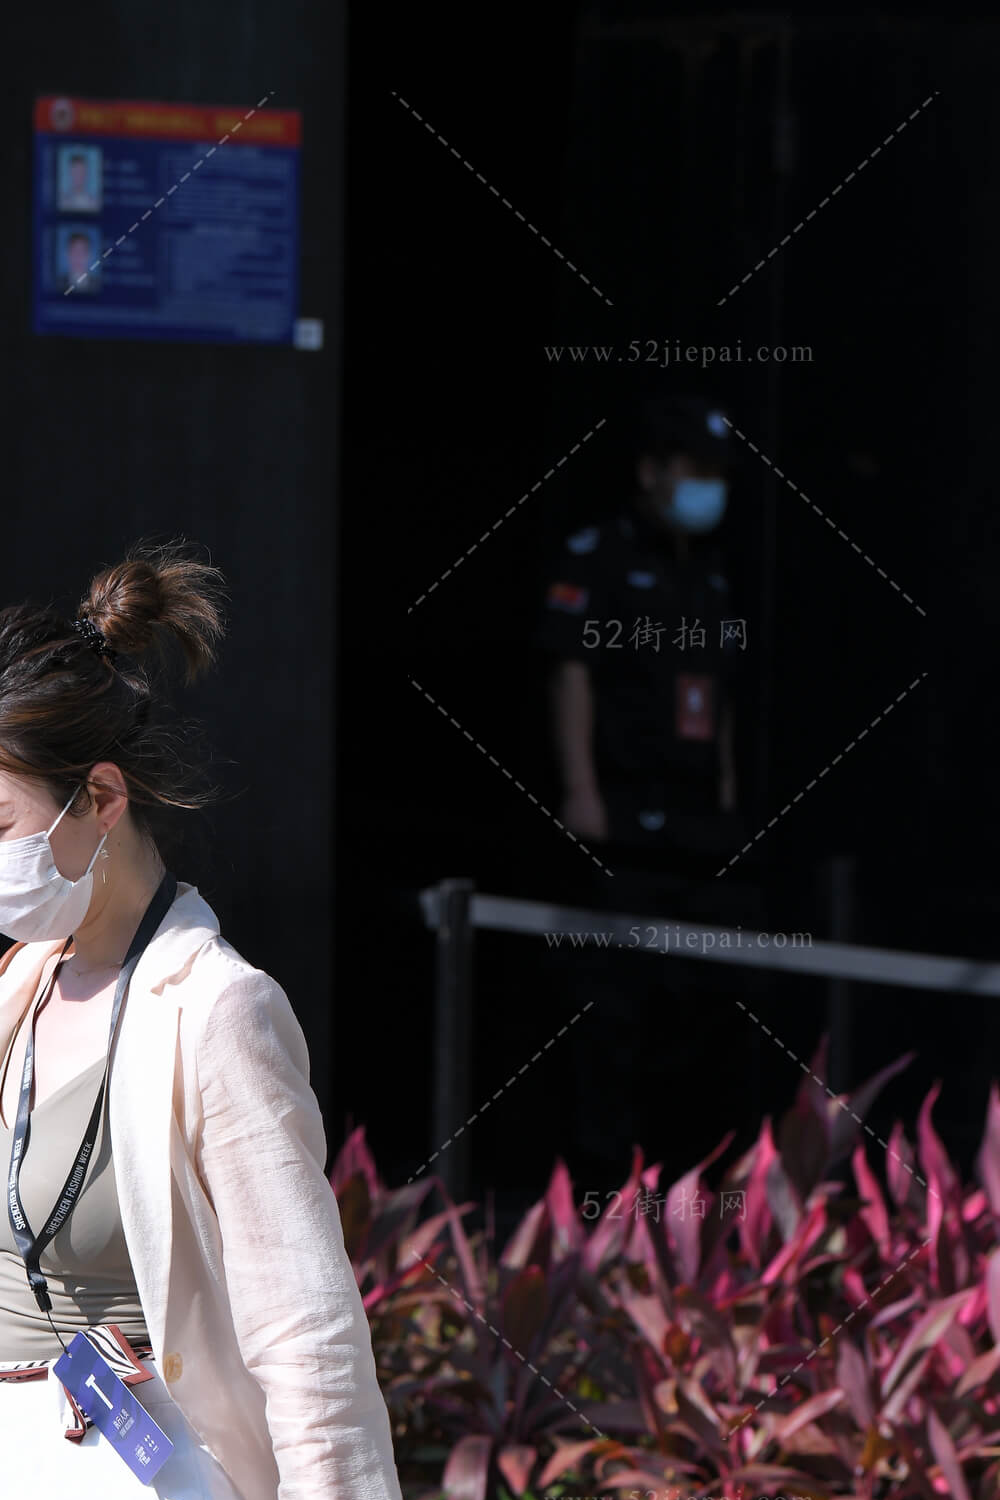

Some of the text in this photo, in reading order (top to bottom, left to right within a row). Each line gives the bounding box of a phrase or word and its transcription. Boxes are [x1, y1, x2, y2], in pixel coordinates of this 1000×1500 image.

[45, 1142, 93, 1235] SHENZHEN FASHION WEEK
